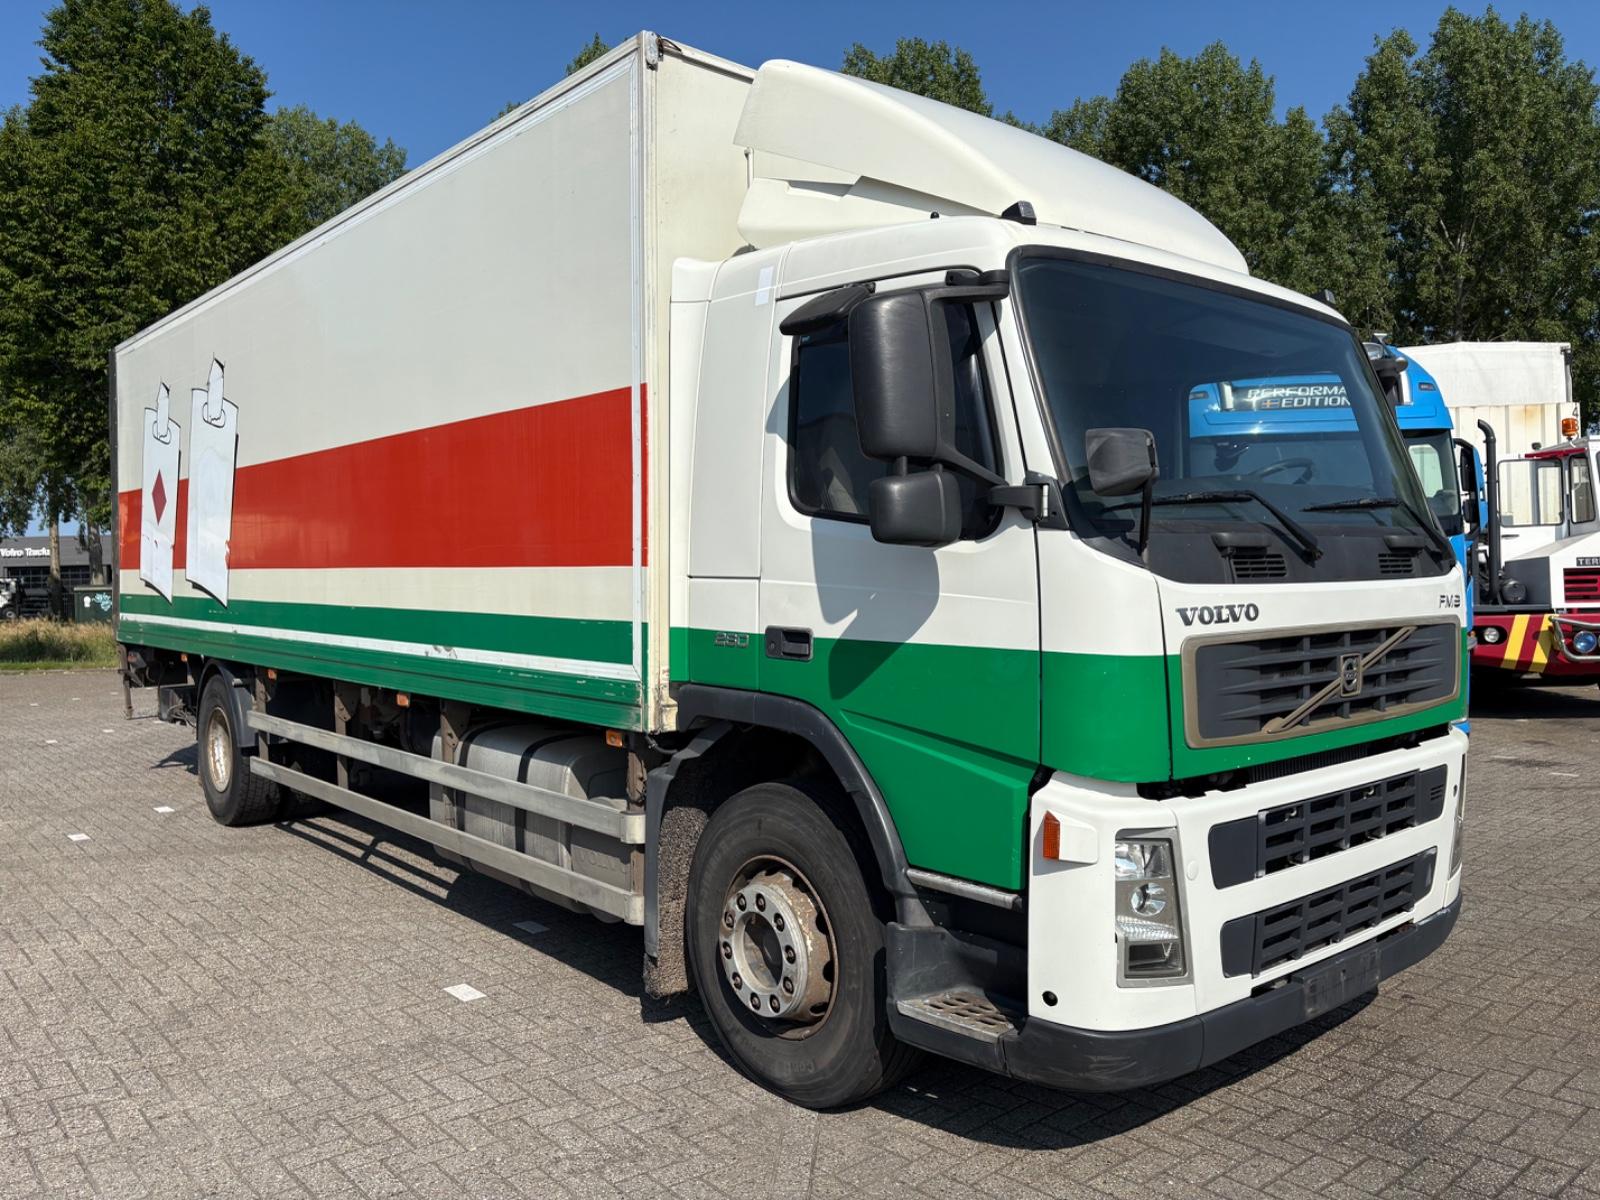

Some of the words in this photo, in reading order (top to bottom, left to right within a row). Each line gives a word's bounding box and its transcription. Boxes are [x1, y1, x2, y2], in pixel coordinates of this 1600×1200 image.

[1281, 396, 1351, 408] EDITION
[0, 547, 24, 558] Volvo
[1577, 558, 1600, 566] TER
[1175, 603, 1259, 626] VOLVO
